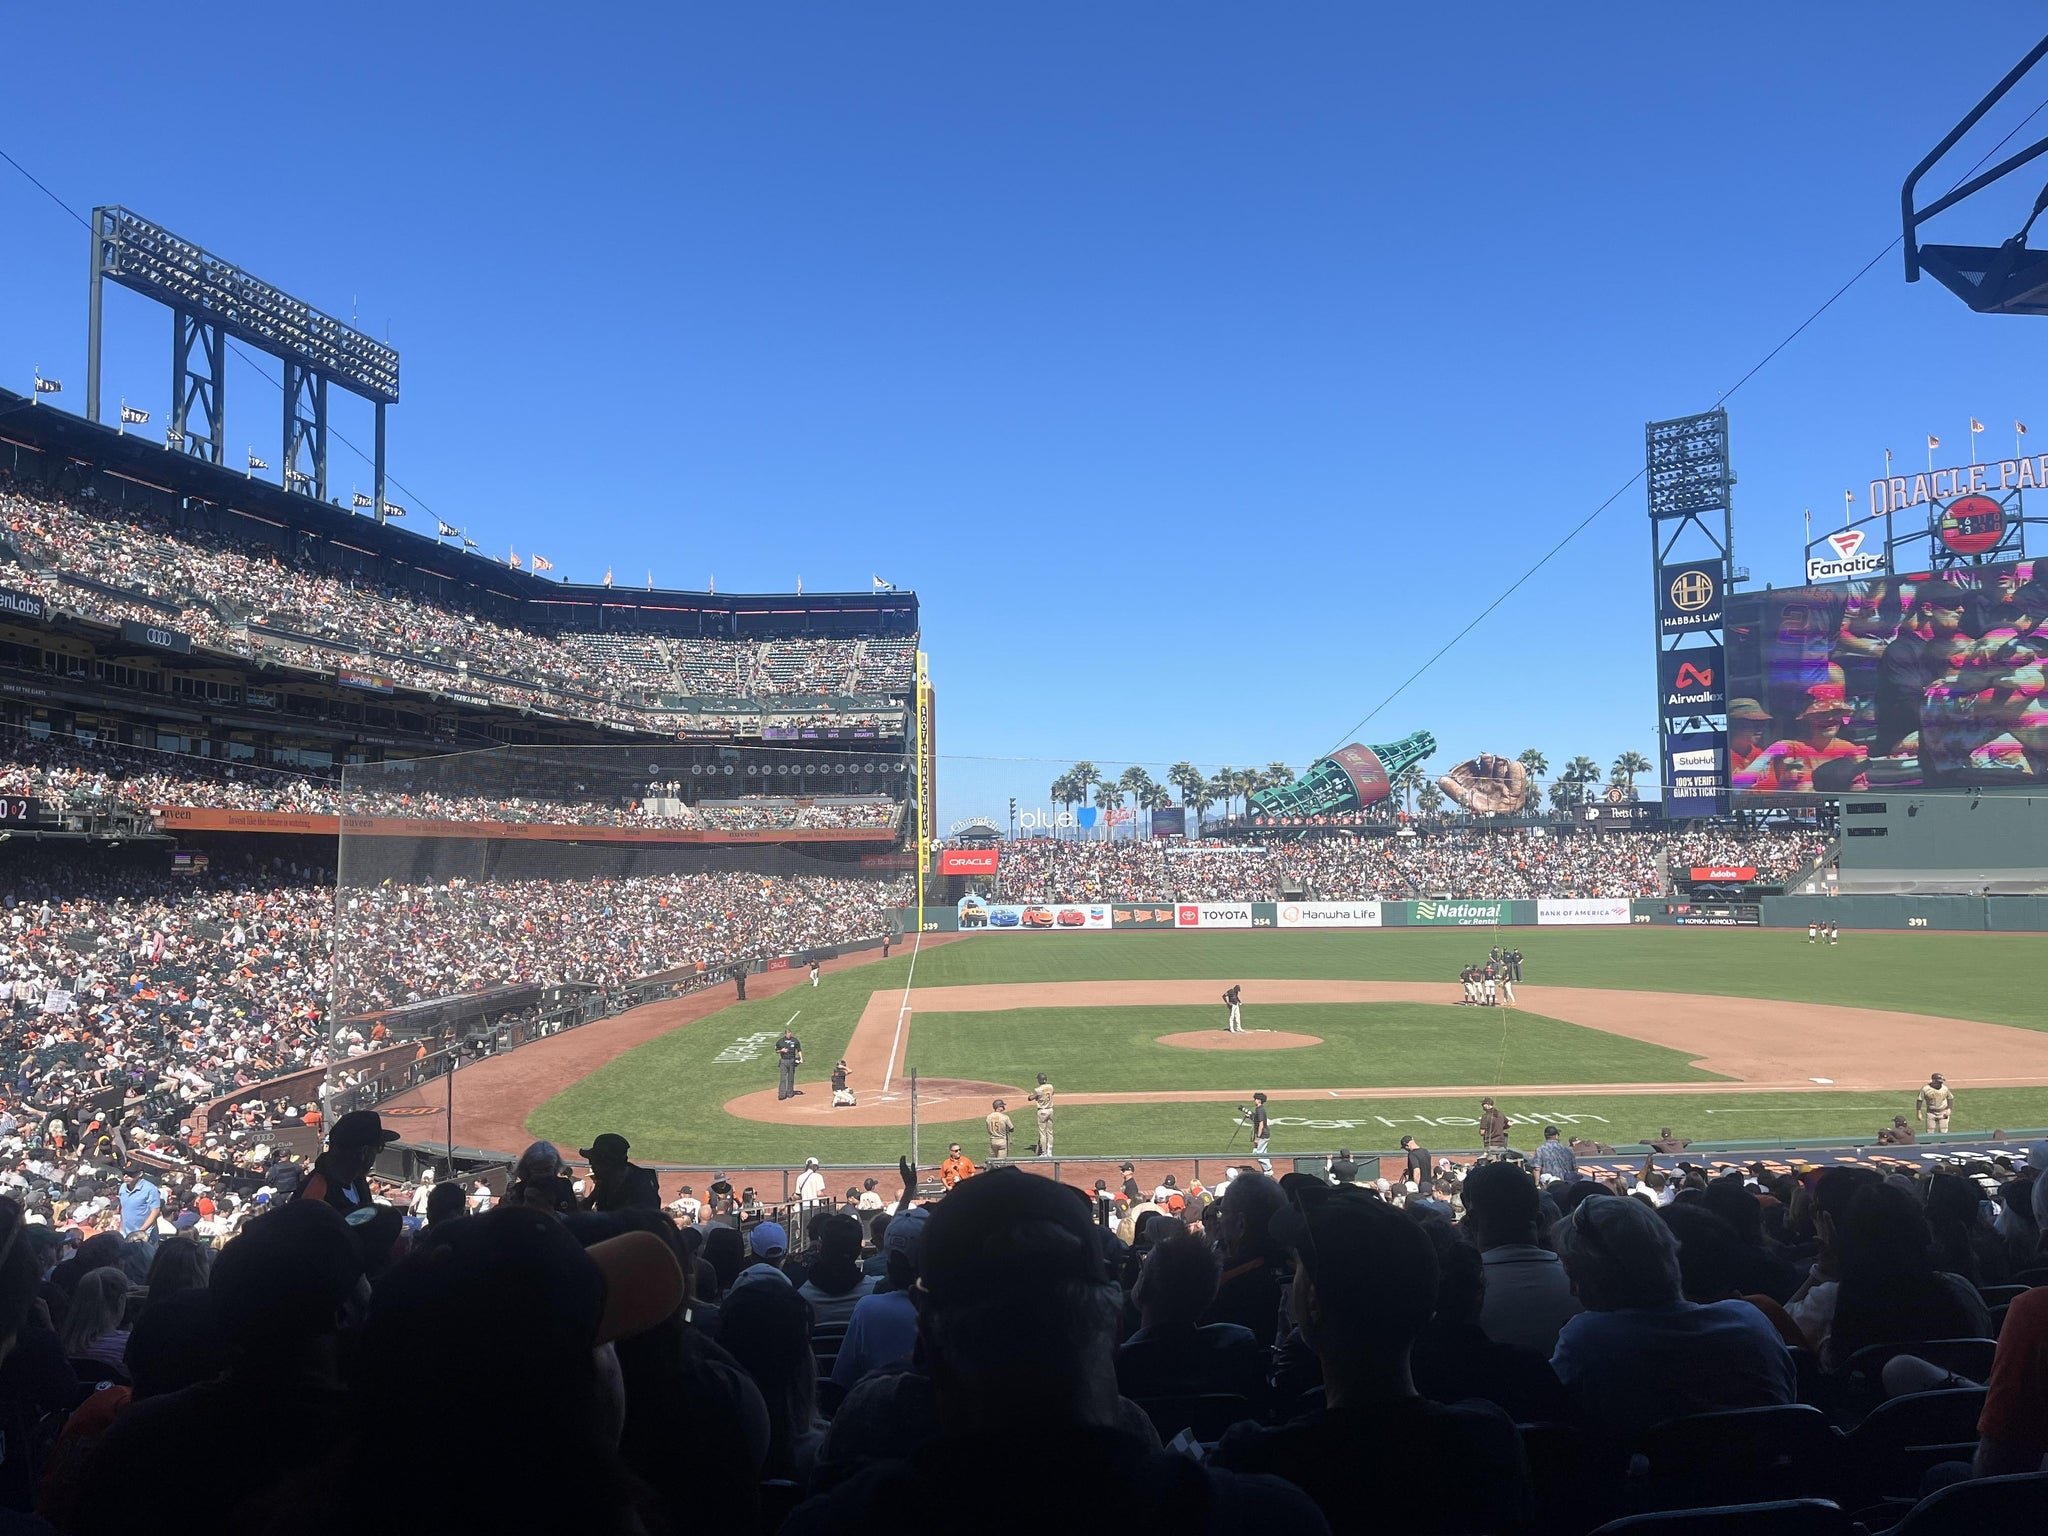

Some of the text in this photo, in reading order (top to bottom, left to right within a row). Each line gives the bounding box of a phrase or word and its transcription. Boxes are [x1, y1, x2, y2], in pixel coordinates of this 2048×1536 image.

[1870, 464, 1987, 517] ORACLE
[1965, 517, 1971, 525] 6
[1965, 526, 1971, 534] 3
[1811, 554, 1886, 577] Fanatics
[1664, 611, 1723, 627] HABBAS LAW
[1668, 692, 1723, 705] Airwallex
[1680, 756, 1717, 766] StubHub
[1675, 777, 1693, 787] 100%
[1673, 787, 1698, 798] GIANTS
[18, 800, 27, 820] 2
[920, 788, 929, 838] CHIKIN
[228, 815, 246, 825] Invest
[257, 815, 266, 826] the
[1020, 807, 1073, 828] blue
[949, 858, 993, 866] ORACLE
[1709, 870, 1737, 878] Adobe
[1203, 911, 1248, 920] TOYOTA
[1302, 909, 1376, 919] Hanwha Life
[1436, 903, 1501, 918] National
[1253, 918, 1271, 926] 354
[1634, 915, 1651, 923] 399
[1709, 918, 1737, 926] MINOLTA
[1908, 918, 1928, 927] 391
[922, 923, 938, 931] 339
[1374, 1112, 1611, 1127] Helth
